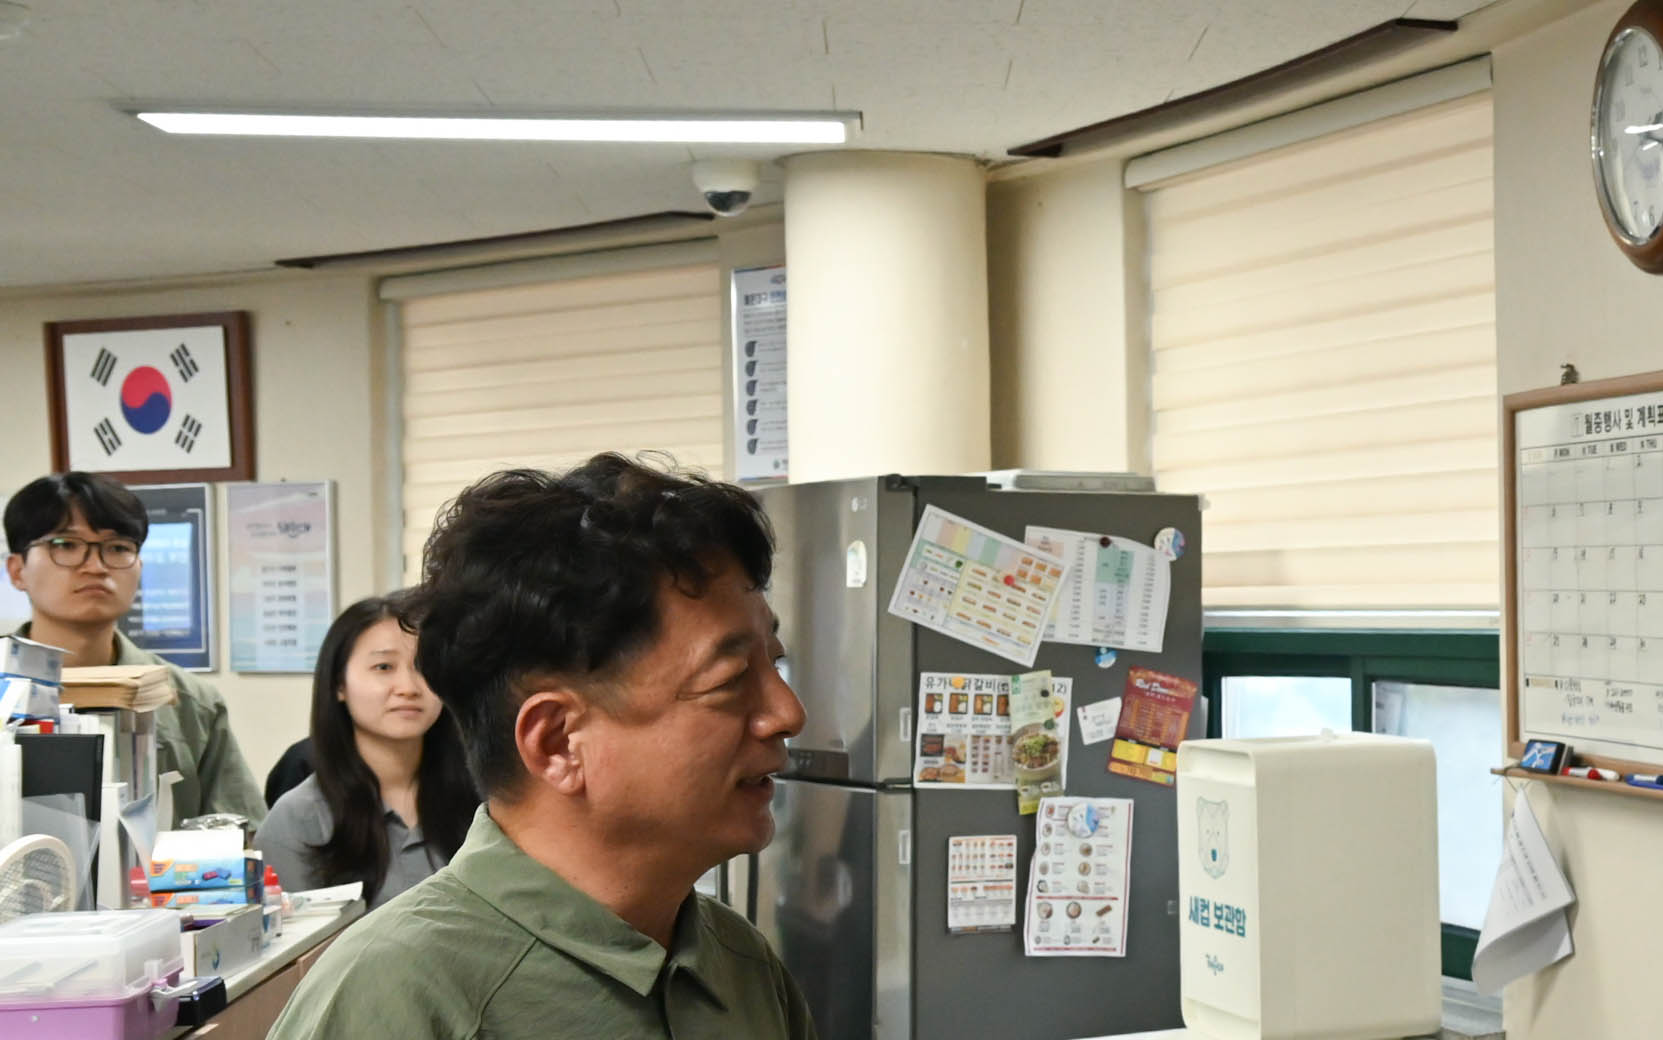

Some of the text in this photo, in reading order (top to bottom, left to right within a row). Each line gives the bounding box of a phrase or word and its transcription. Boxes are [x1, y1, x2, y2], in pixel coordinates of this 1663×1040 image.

[1585, 408, 1621, 435] 월중행사
[1624, 407, 1634, 431] 및
[1213, 901, 1247, 938] 보관함
